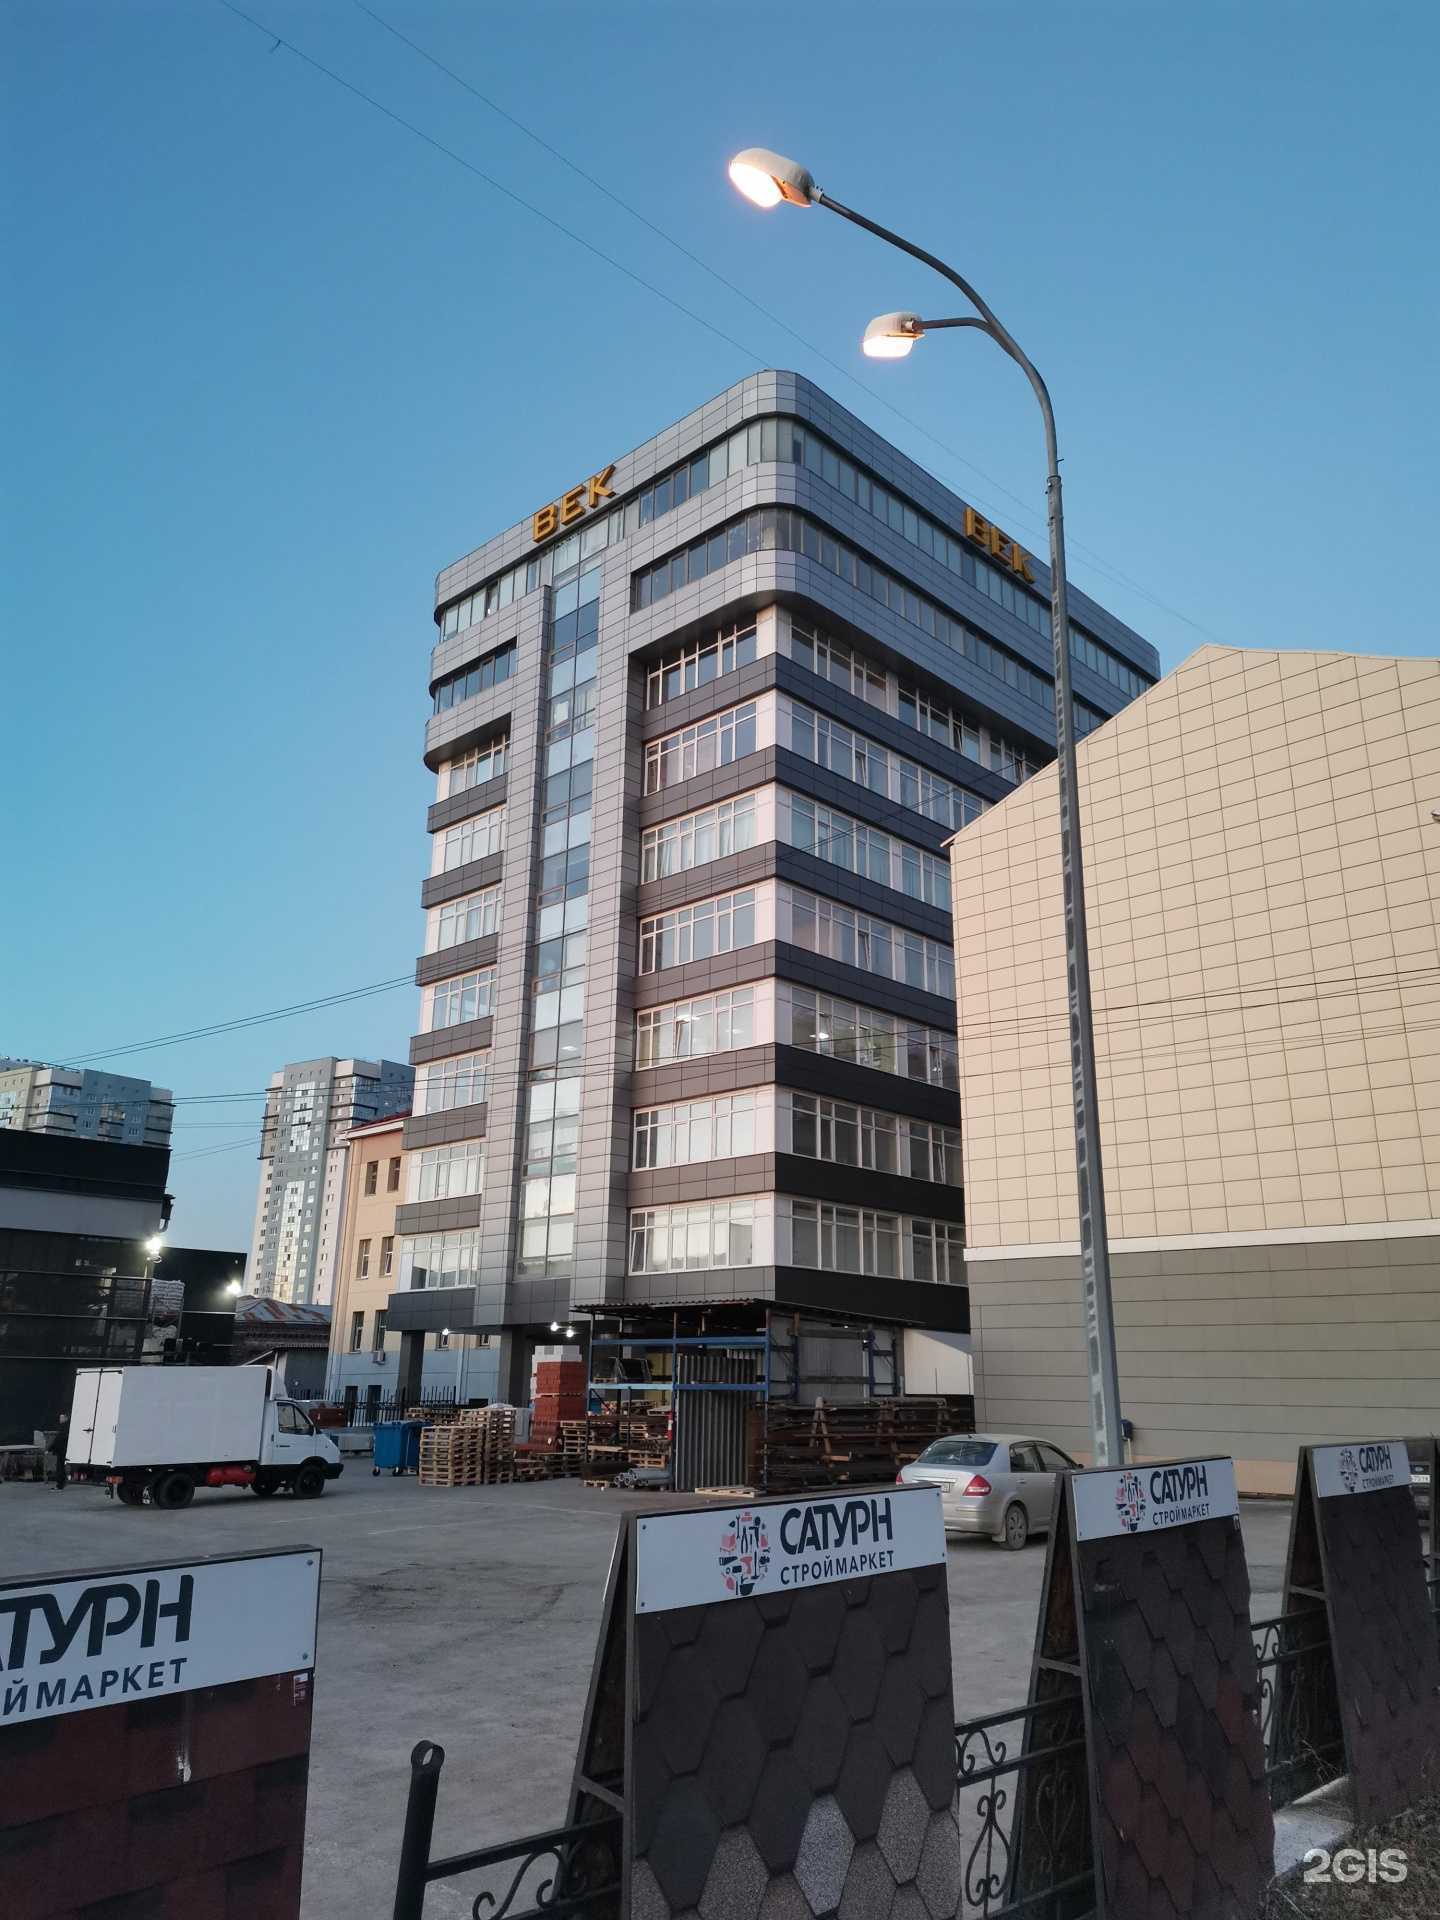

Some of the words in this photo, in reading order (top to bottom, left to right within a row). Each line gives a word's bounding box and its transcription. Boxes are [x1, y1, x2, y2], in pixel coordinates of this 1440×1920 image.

[533, 464, 616, 543] ВЕК
[1359, 1445, 1392, 1473] САТУРН
[1150, 1465, 1208, 1504] САТУРН
[780, 1498, 893, 1555] САТУРН
[1153, 1503, 1209, 1525] СТРОЙМАРКЕТ
[781, 1551, 894, 1585] СТРОЙМАРКЕТ
[0, 1575, 194, 1671] ТУРН
